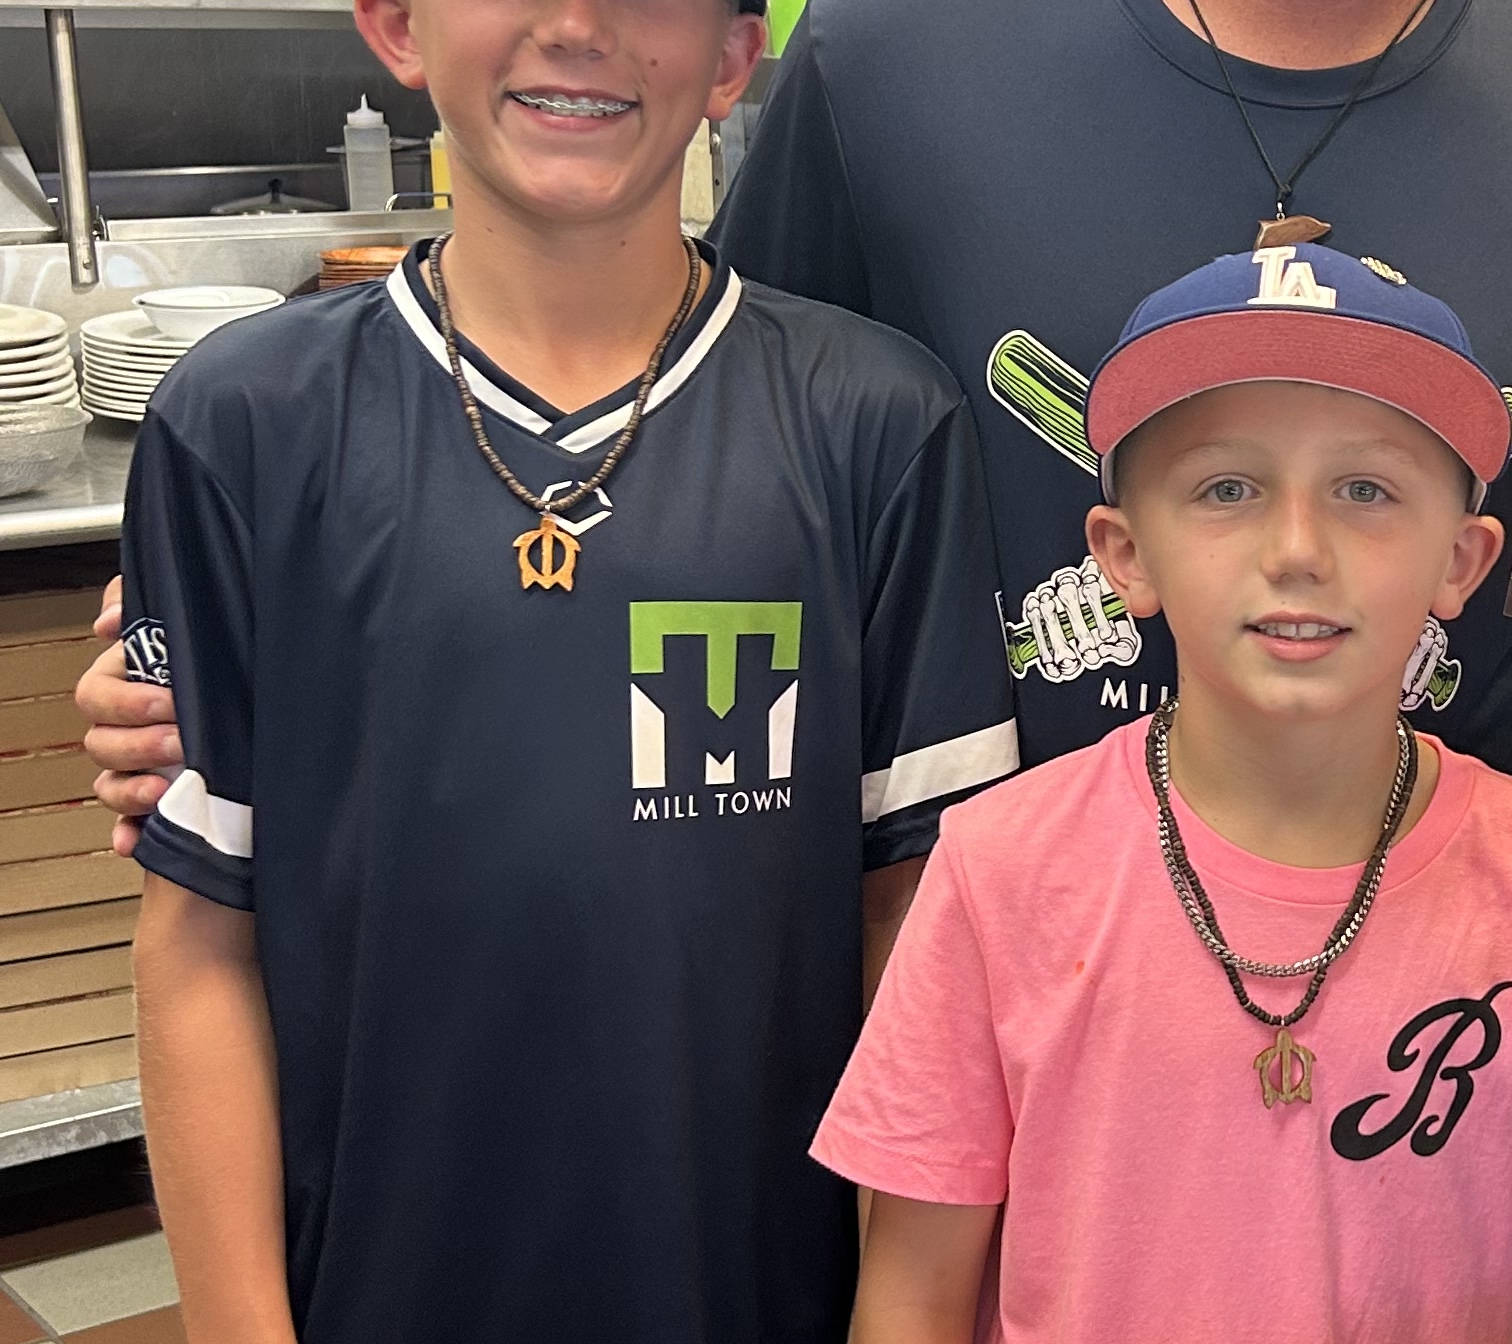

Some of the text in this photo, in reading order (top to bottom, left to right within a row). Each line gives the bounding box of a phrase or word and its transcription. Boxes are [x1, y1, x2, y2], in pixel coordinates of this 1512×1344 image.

[1247, 245, 1337, 310] LA
[632, 786, 793, 821] MILL TOWN
